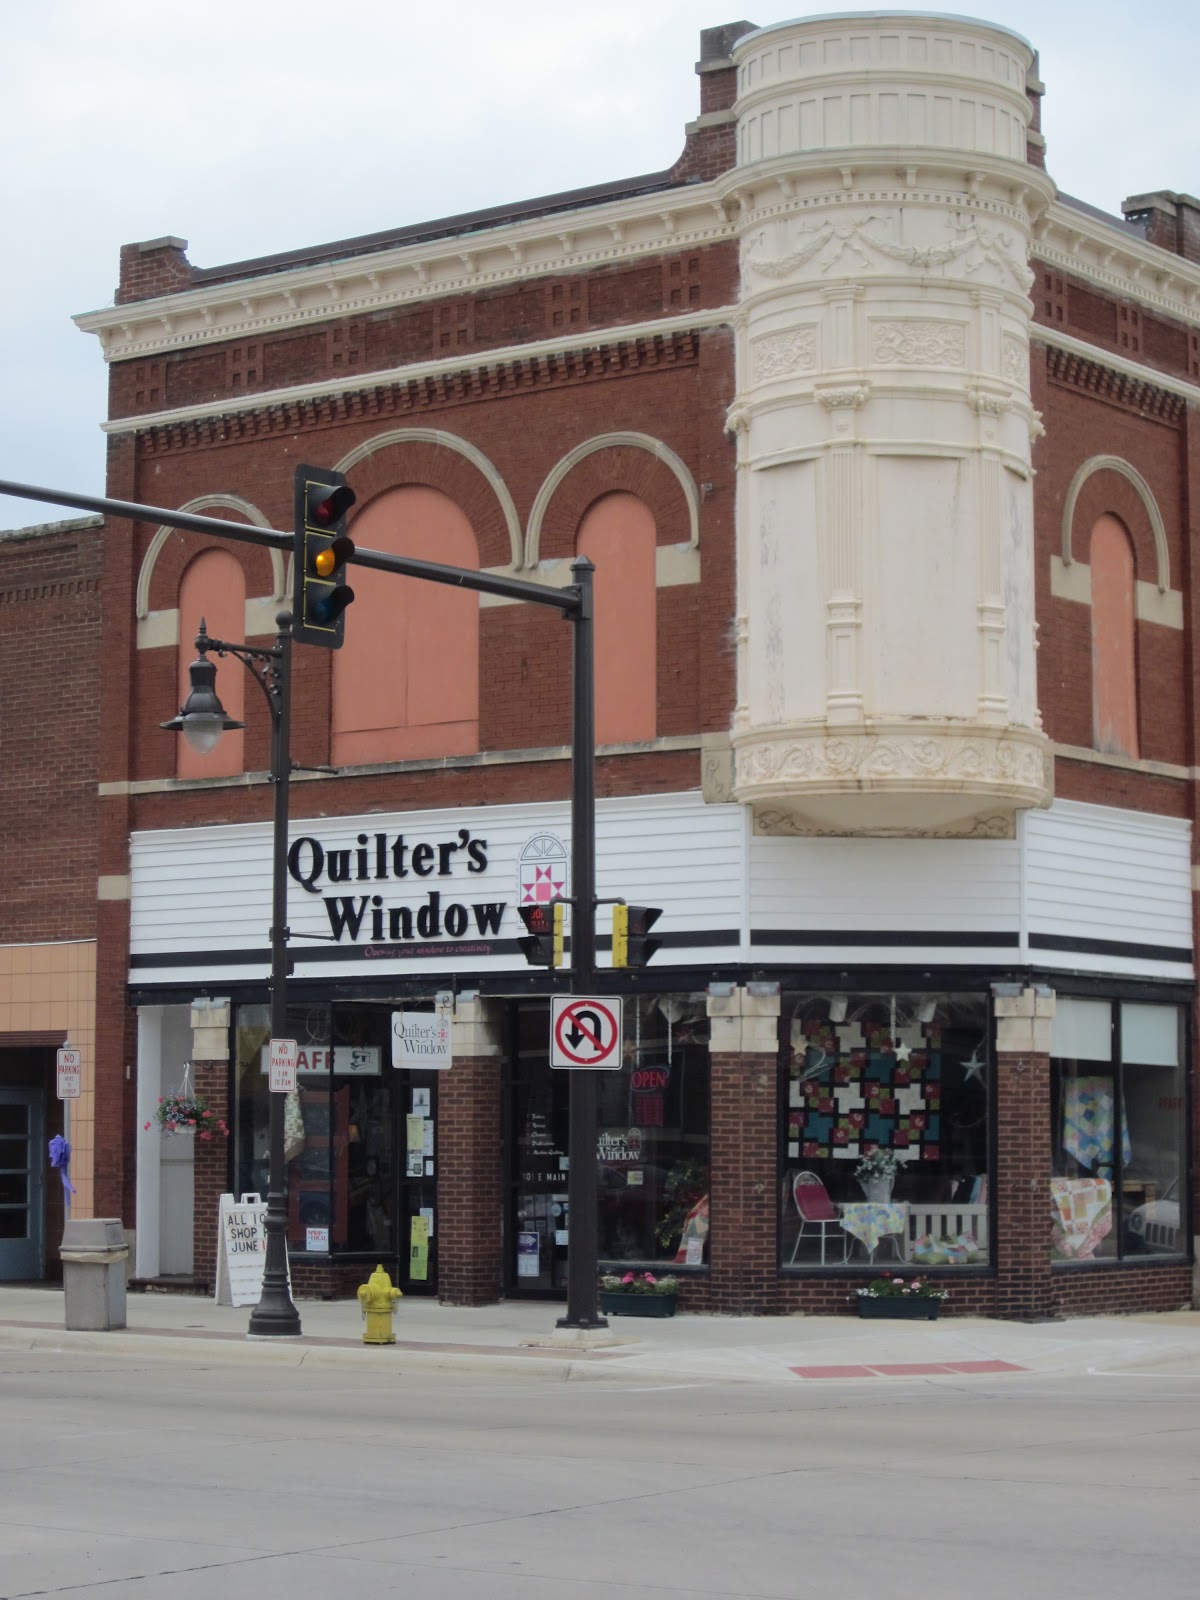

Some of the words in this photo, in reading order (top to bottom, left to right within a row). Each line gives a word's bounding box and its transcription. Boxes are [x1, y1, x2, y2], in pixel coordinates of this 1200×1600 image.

[287, 829, 489, 893] Quilter's
[323, 891, 508, 942] Window
[365, 945, 396, 958] Opening
[416, 945, 443, 955] window
[446, 945, 454, 953] to
[394, 1022, 436, 1039] Quilter's
[278, 1046, 288, 1055] NO
[404, 1039, 448, 1054] Window
[64, 1054, 75, 1063] NO
[272, 1058, 295, 1067] PARKING
[296, 1051, 336, 1069] AFF
[59, 1065, 80, 1074] PARKING
[632, 1071, 666, 1088] OPEN
[597, 1132, 628, 1146] uilter's
[596, 1146, 641, 1160] Window
[538, 1173, 542, 1181] E
[546, 1173, 566, 1181] MAIN
[228, 1214, 247, 1225] ALL
[231, 1227, 257, 1239] SHOP
[232, 1241, 258, 1252] JUNE
